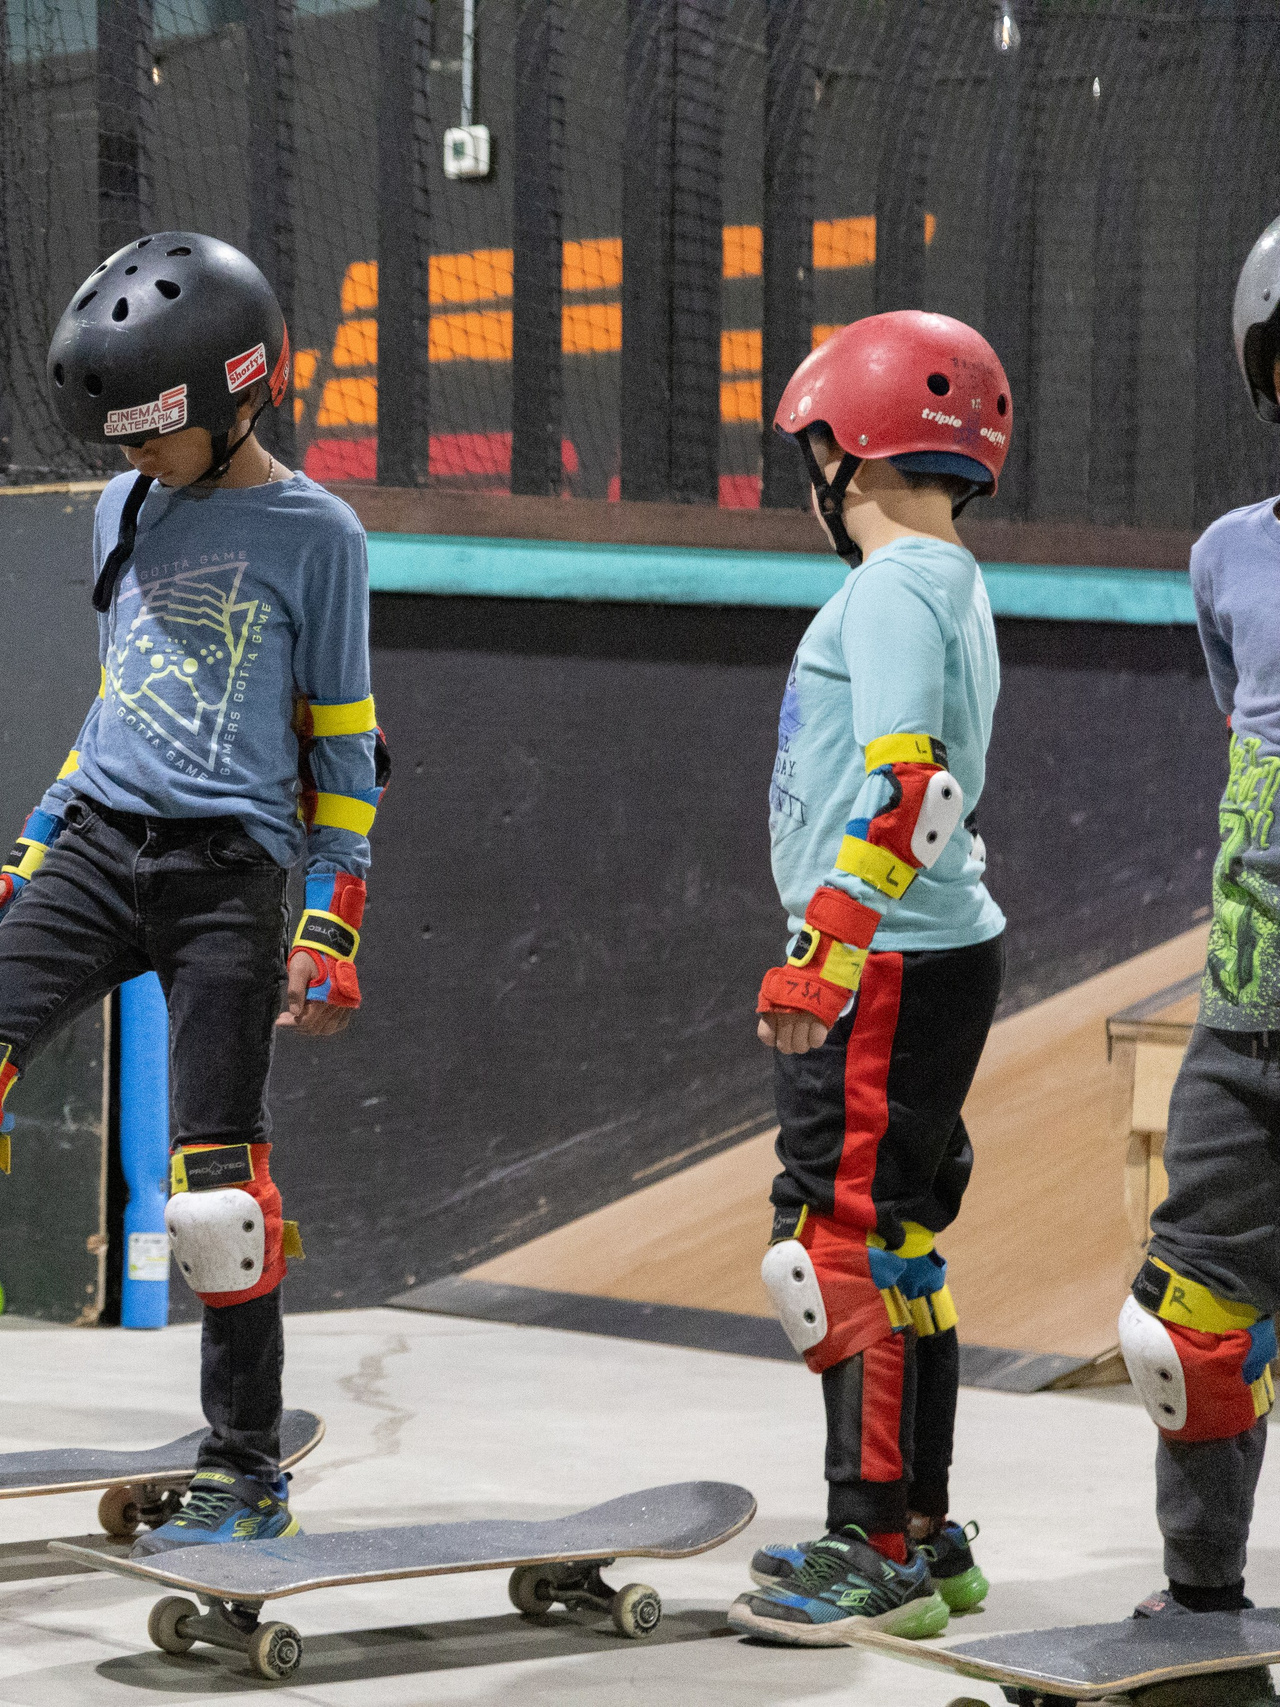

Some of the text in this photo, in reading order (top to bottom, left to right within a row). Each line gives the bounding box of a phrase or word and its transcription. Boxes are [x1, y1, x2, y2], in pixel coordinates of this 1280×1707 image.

[229, 351, 265, 386] Shorty's
[105, 411, 173, 434] SKATEPARK
[110, 403, 161, 424] CINEMA
[922, 408, 962, 428] triple
[140, 550, 248, 580] GOTTA GAME
[220, 601, 272, 776] GAMERS GOTTA GAME
[116, 706, 209, 783] GOTTA GAME
[886, 865, 899, 888] L
[188, 1168, 210, 1176] PRO
[1169, 1286, 1193, 1314] R
